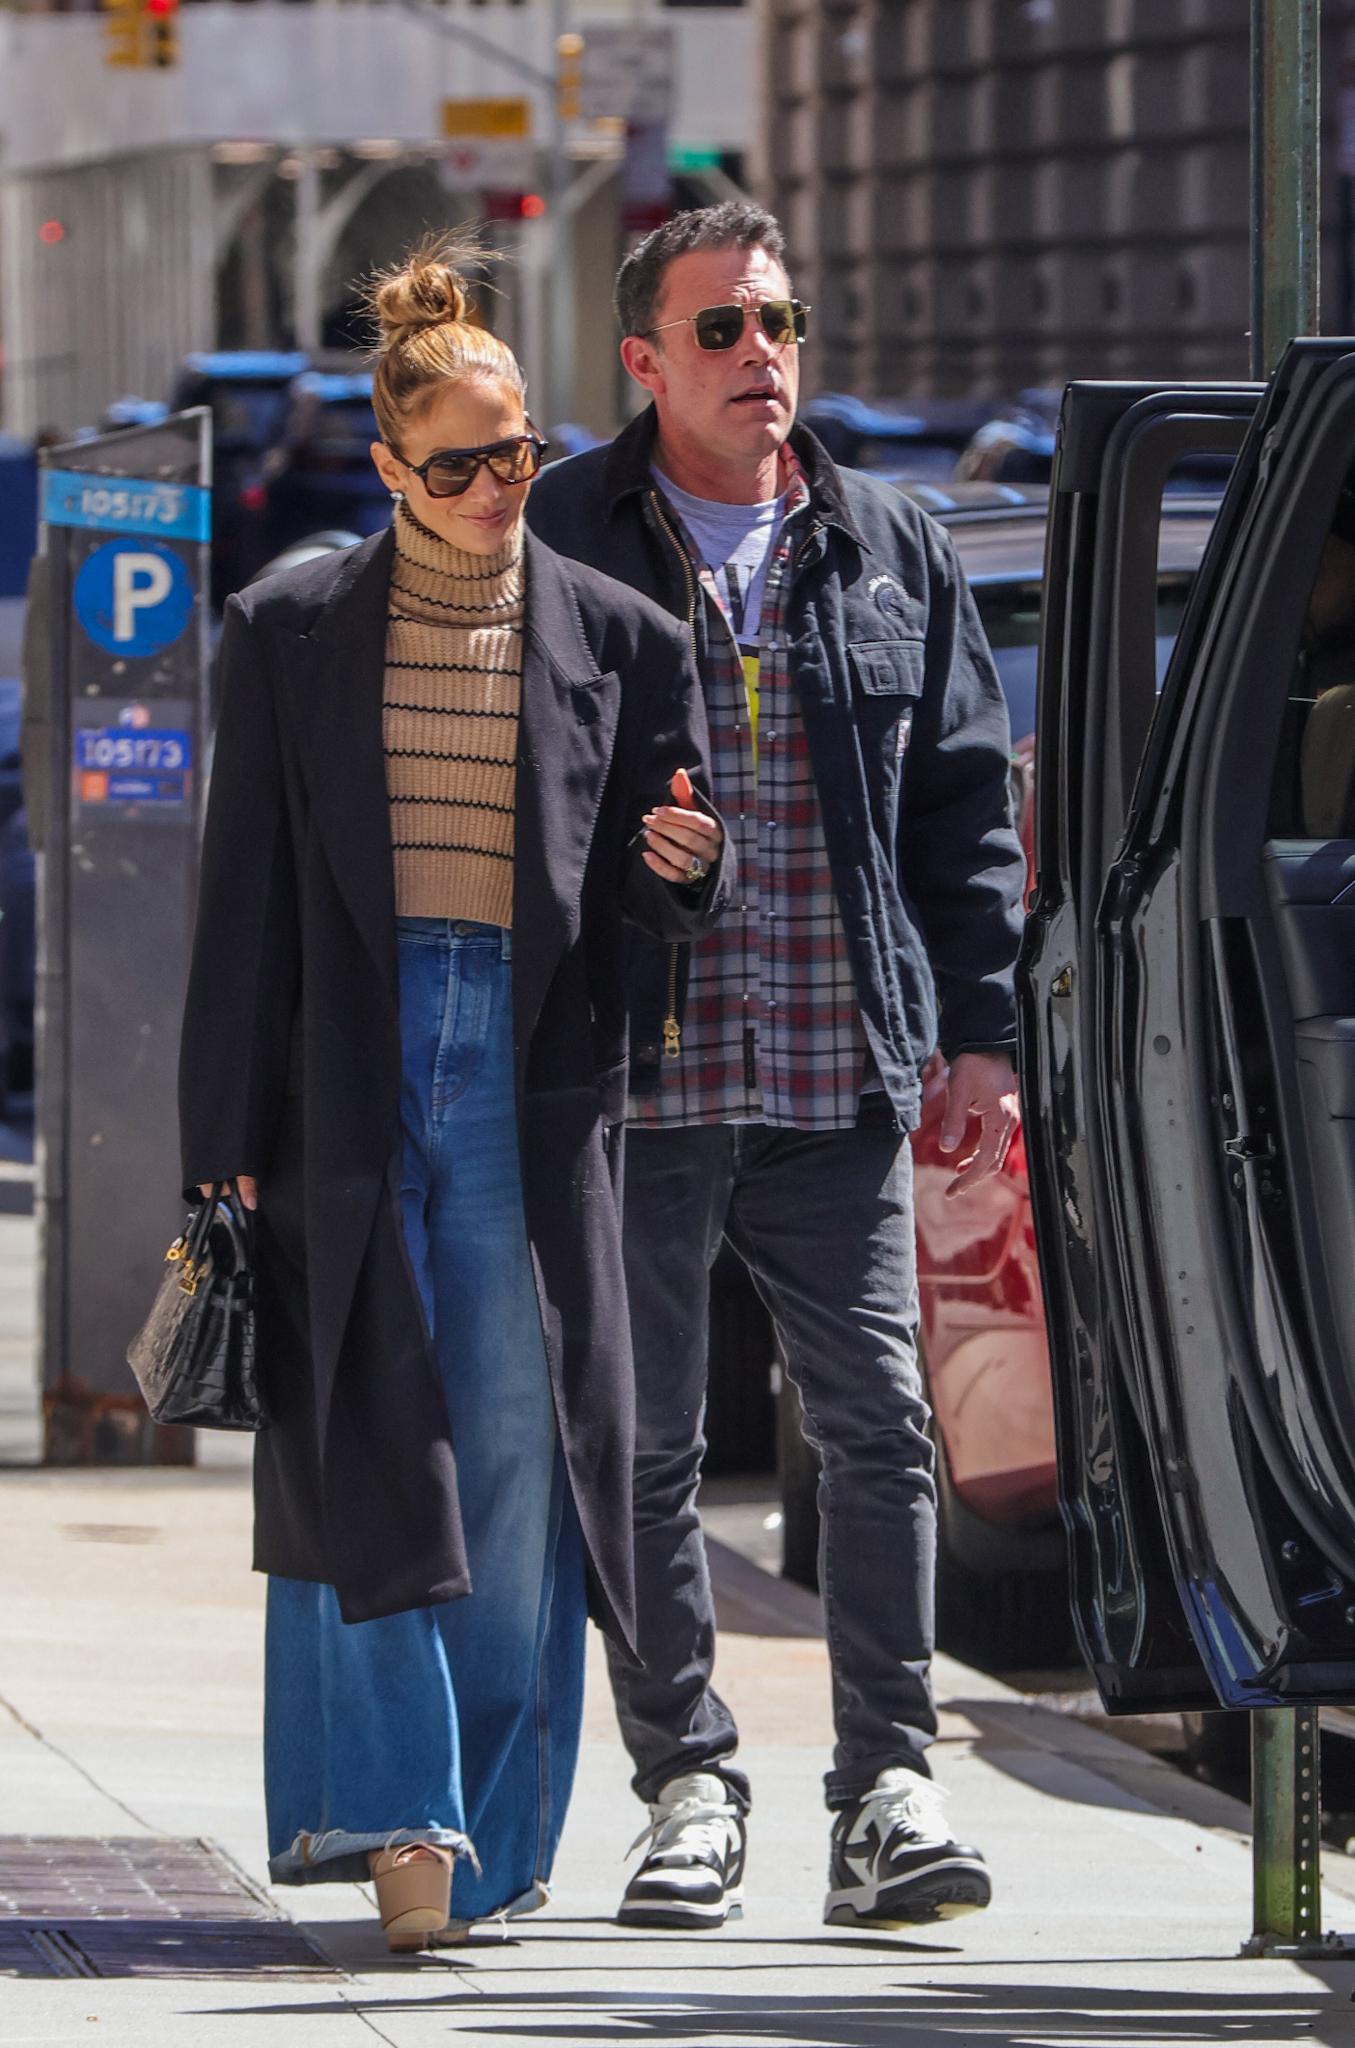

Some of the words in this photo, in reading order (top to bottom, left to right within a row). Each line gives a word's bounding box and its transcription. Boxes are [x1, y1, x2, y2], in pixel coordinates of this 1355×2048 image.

[82, 488, 180, 523] 105173
[113, 552, 172, 642] P
[85, 738, 182, 768] 105173
